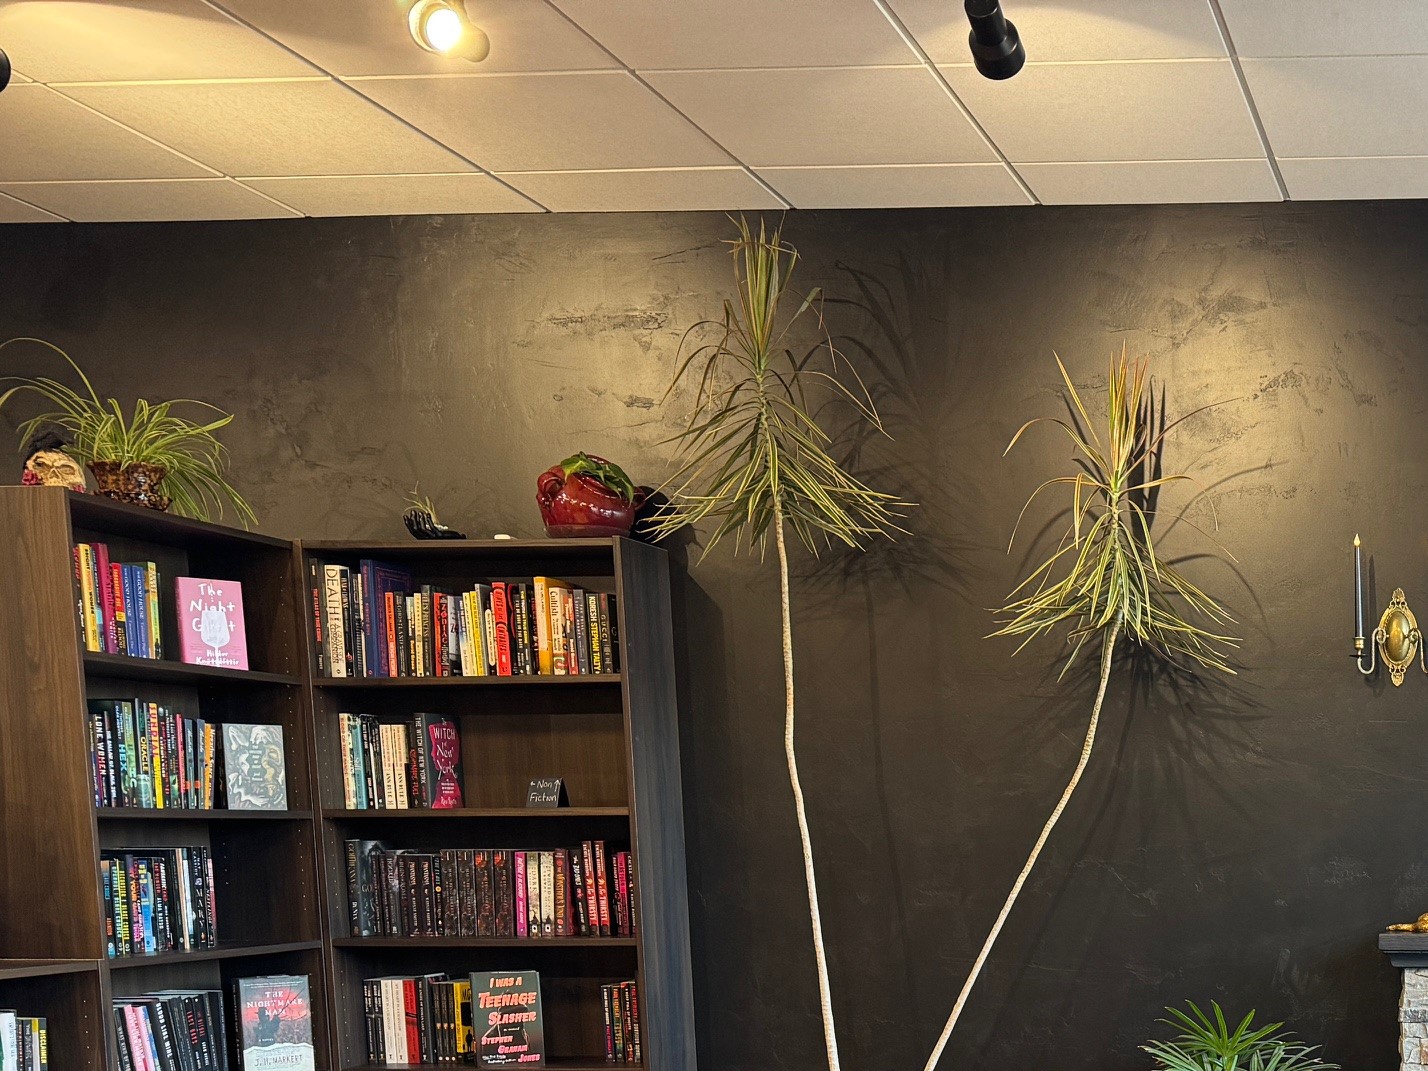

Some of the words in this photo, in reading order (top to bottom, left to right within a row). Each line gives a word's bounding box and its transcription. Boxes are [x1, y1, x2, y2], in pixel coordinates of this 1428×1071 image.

[198, 583, 223, 596] The
[326, 569, 340, 615] DEATH
[550, 591, 559, 616] Cultish
[588, 596, 597, 621] KORESH
[591, 622, 599, 651] STEPHAN
[593, 652, 601, 670] TALTY
[95, 716, 104, 738] LONE
[150, 706, 159, 758] SUNDIAL
[434, 727, 456, 740] WITCH
[97, 742, 107, 776] WOMEN
[118, 744, 127, 772] HEX
[140, 736, 149, 772] ORACLE
[436, 744, 454, 758] New
[436, 759, 457, 780] York
[537, 779, 553, 788] Non
[530, 792, 557, 802] Fiction
[588, 896, 596, 921] THIRSTY
[496, 977, 514, 988] WAS
[516, 976, 523, 986] A
[246, 998, 303, 1008] NIGHTMARE
[478, 991, 537, 1009] TEENAGE
[155, 1002, 164, 1024] BLOOD
[186, 1011, 195, 1026] LAST
[488, 1011, 537, 1026] SLASHER
[160, 1025, 169, 1040] LIKE
[190, 1029, 198, 1045] DAYS
[481, 1035, 513, 1046] STEPHEN
[39, 1029, 47, 1064] DISCLAIMER
[164, 1041, 173, 1058] MINE
[497, 1044, 528, 1054] GRAHAM
[272, 1054, 303, 1064] MARKERT
[517, 1053, 541, 1063] JONES
